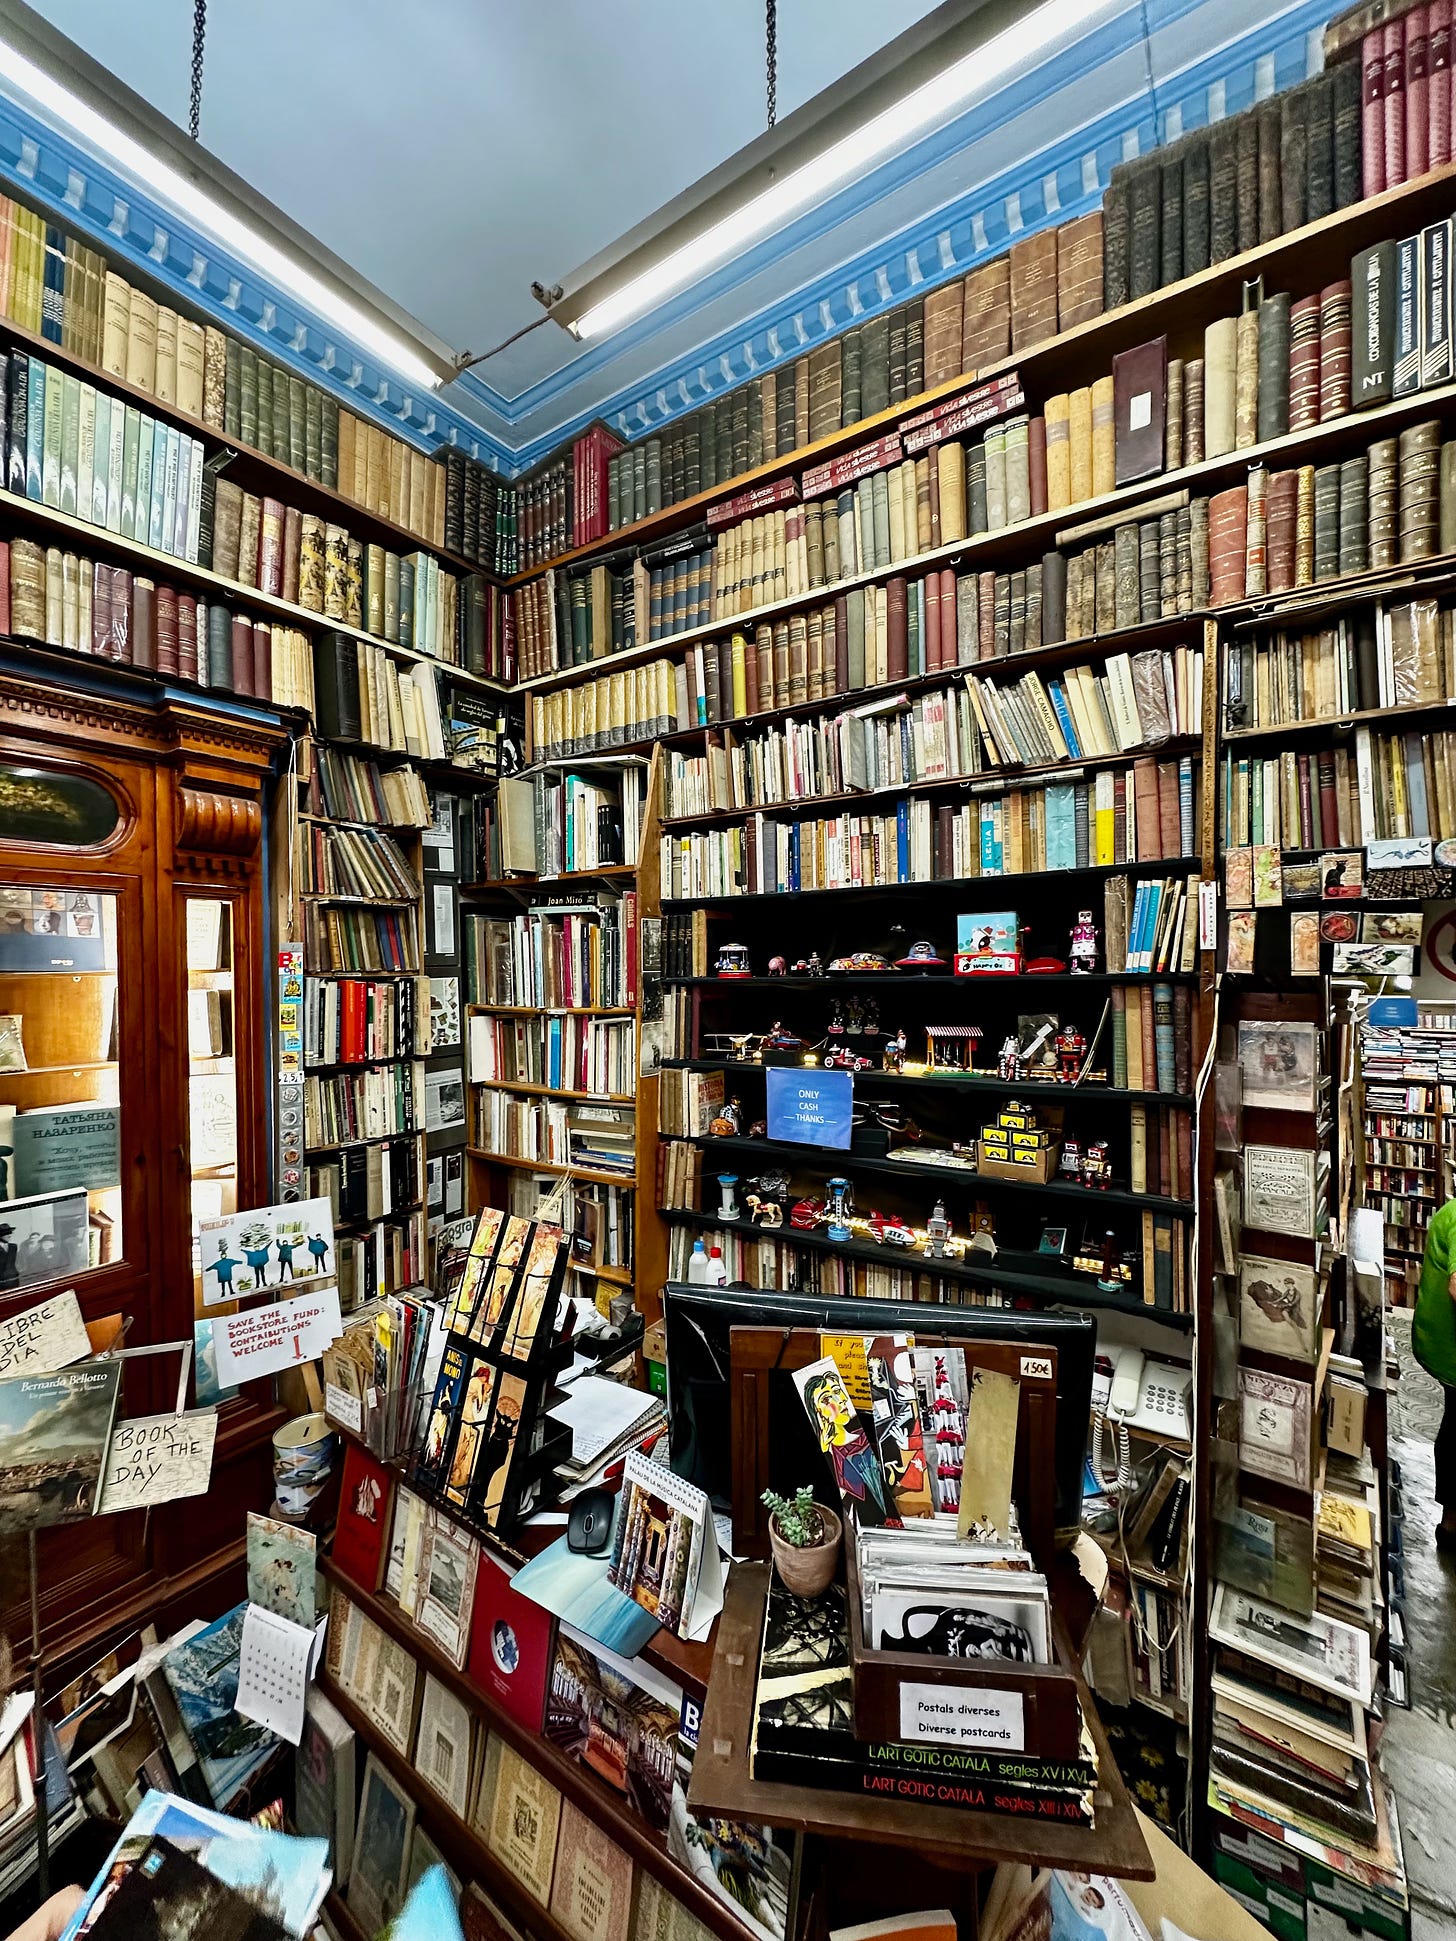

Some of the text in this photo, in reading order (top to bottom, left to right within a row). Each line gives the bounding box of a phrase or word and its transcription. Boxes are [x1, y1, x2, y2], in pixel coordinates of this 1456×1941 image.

[1362, 371, 1385, 389] NT
[1028, 675, 1055, 731] JORGE CAMACHO
[548, 894, 582, 906] Joan Miró
[799, 1090, 819, 1099] ONLY
[799, 1103, 818, 1111] CASH
[52, 1112, 116, 1125] ТАТЬЯНА
[795, 1114, 825, 1124] THANKS
[32, 1123, 116, 1138] НАЗАРЕНКО
[228, 1310, 280, 1330] SAVE THE
[229, 1307, 325, 1339] BOOKSTORE FUND:
[232, 1337, 283, 1357] WELCOME
[443, 1362, 460, 1379] MONO
[20, 1372, 108, 1393] Bernardo Bellotto
[115, 1423, 178, 1452] BOOK
[130, 1441, 201, 1464] OF THE
[107, 1463, 162, 1493] DAY
[629, 1465, 643, 1478] PALAU
[643, 1474, 650, 1482] DE
[650, 1478, 656, 1486] LA
[673, 1494, 698, 1513] CATALANA
[685, 1701, 699, 1730] B
[918, 1702, 1000, 1717] Postals diverses
[918, 1723, 1011, 1739] Diverse postcards
[998, 1762, 1039, 1779] segles
[1042, 1766, 1060, 1780] XV
[994, 1795, 1035, 1813] segles
